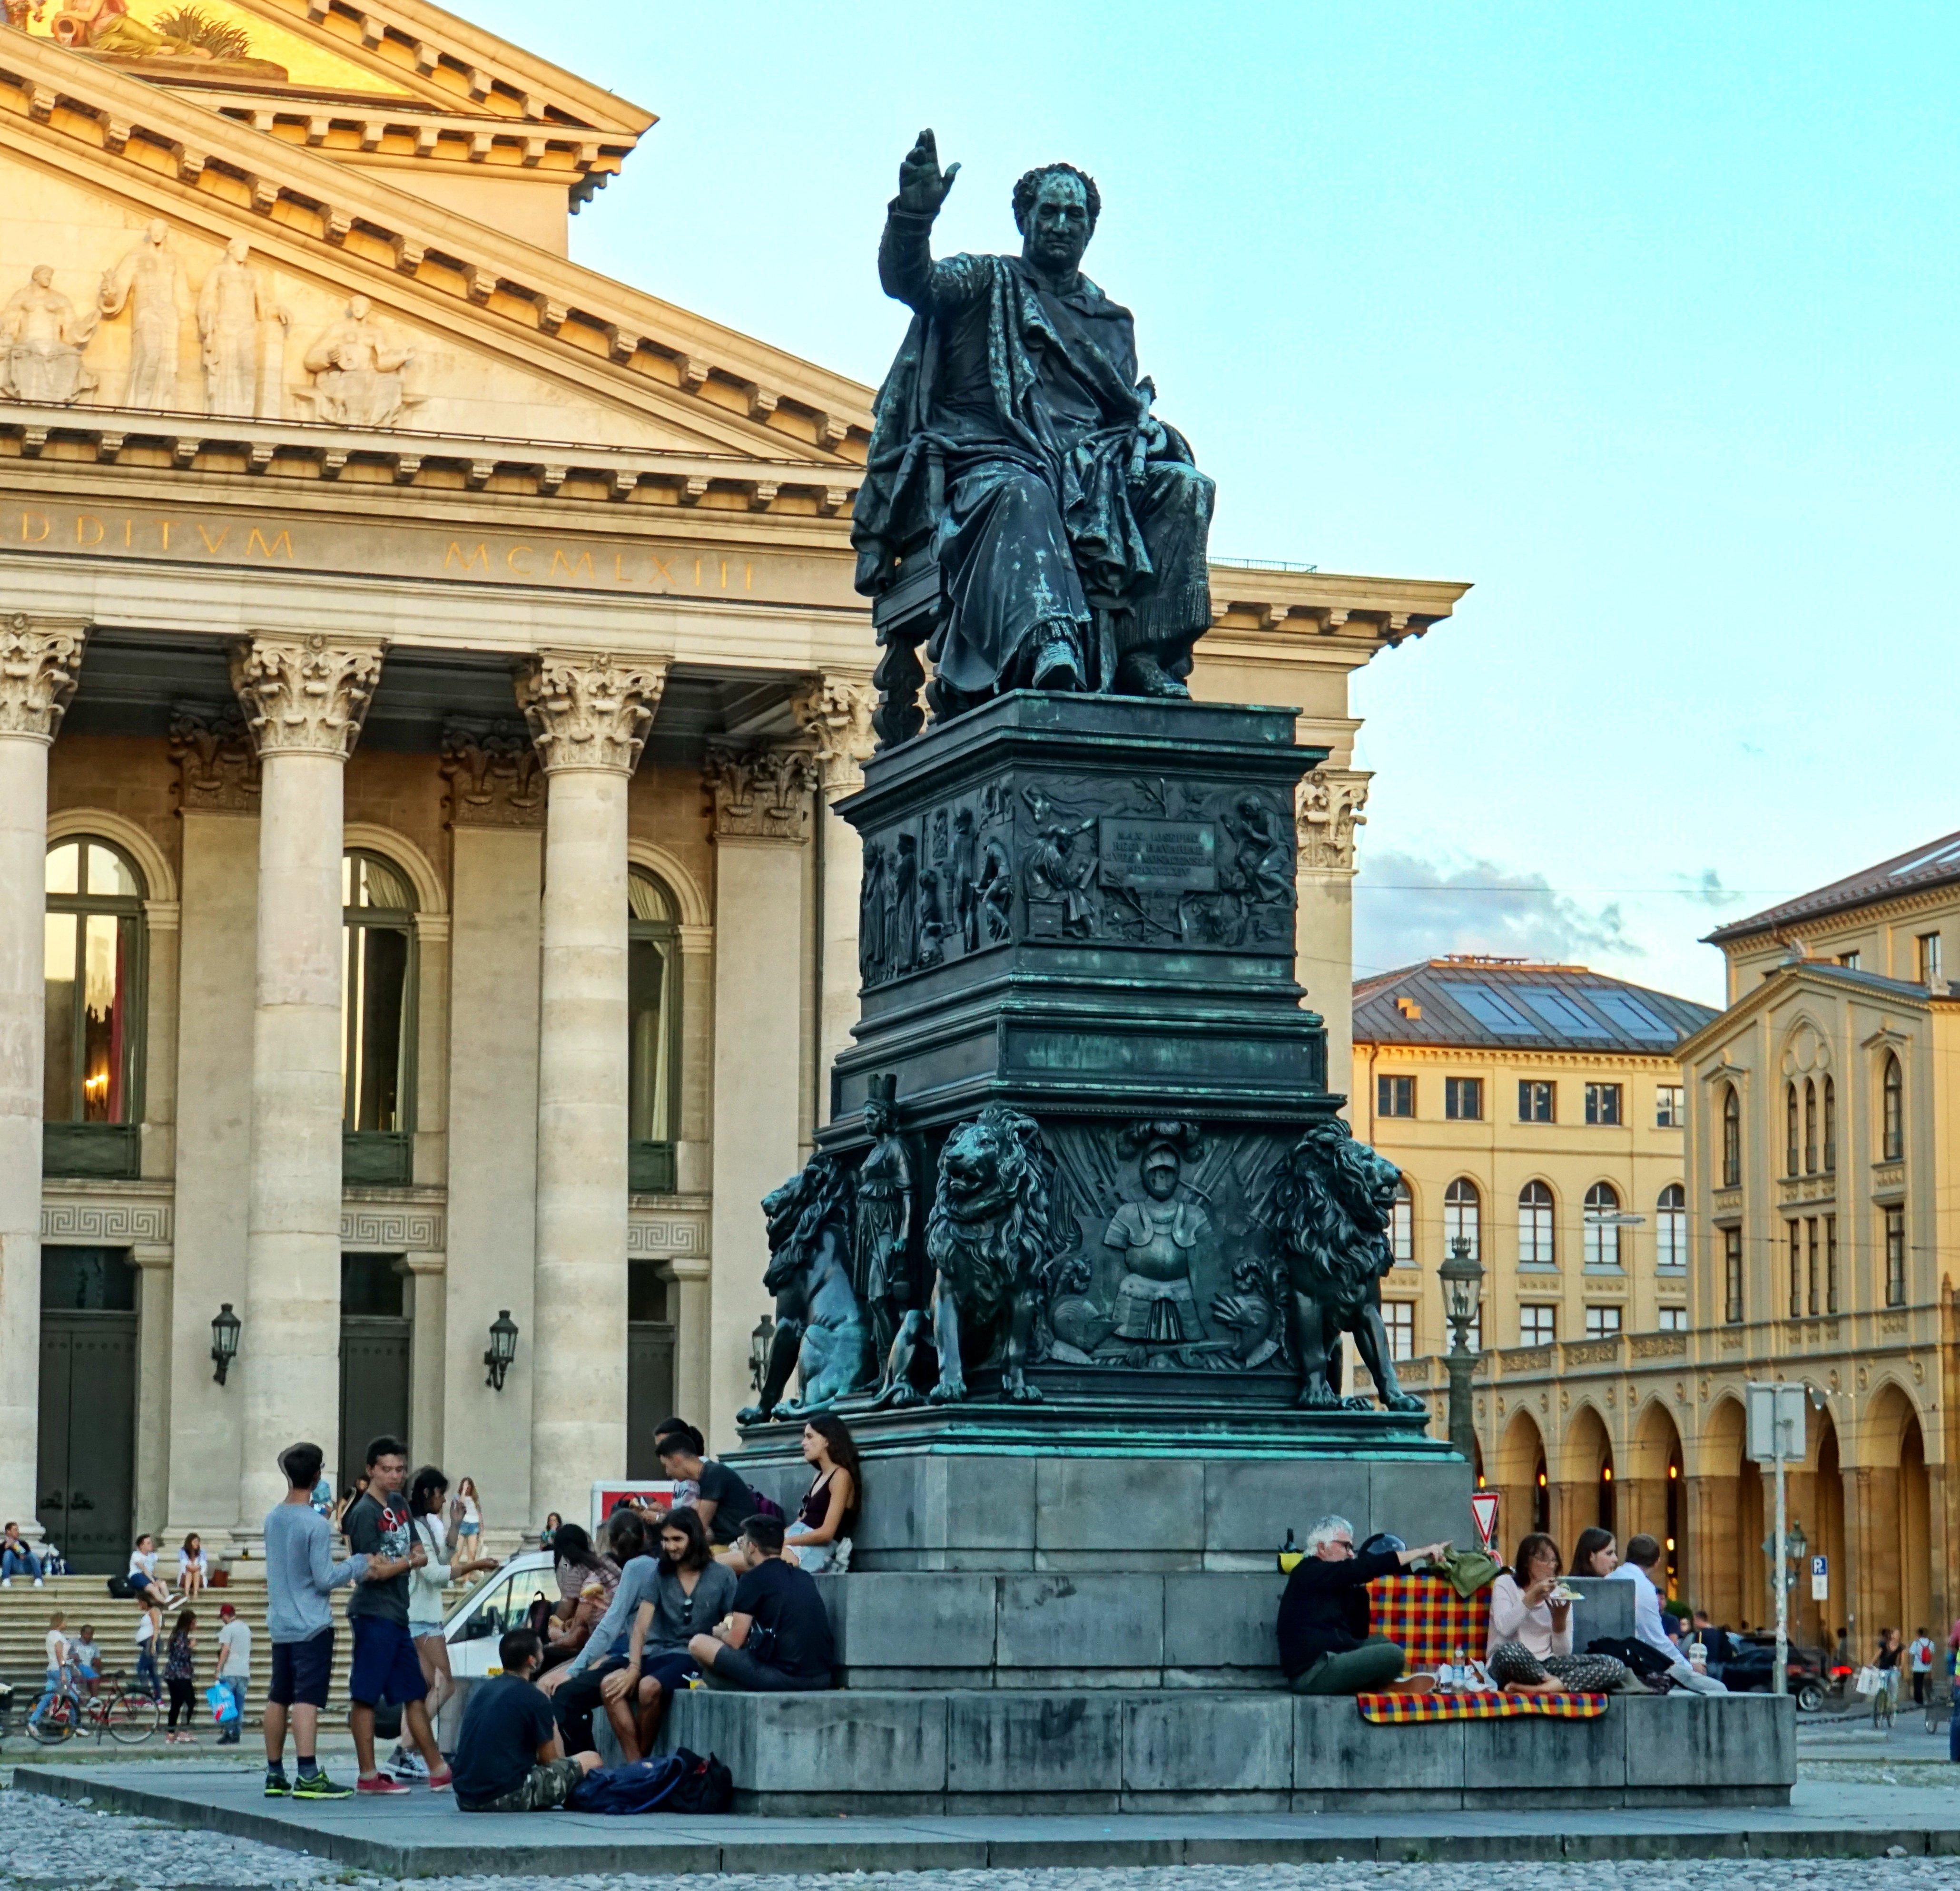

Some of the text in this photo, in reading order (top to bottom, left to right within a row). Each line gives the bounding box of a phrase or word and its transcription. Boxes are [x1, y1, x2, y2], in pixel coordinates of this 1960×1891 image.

[0, 511, 752, 590] DDITVM MCMLXIII
[1813, 1558, 1822, 1574] P
